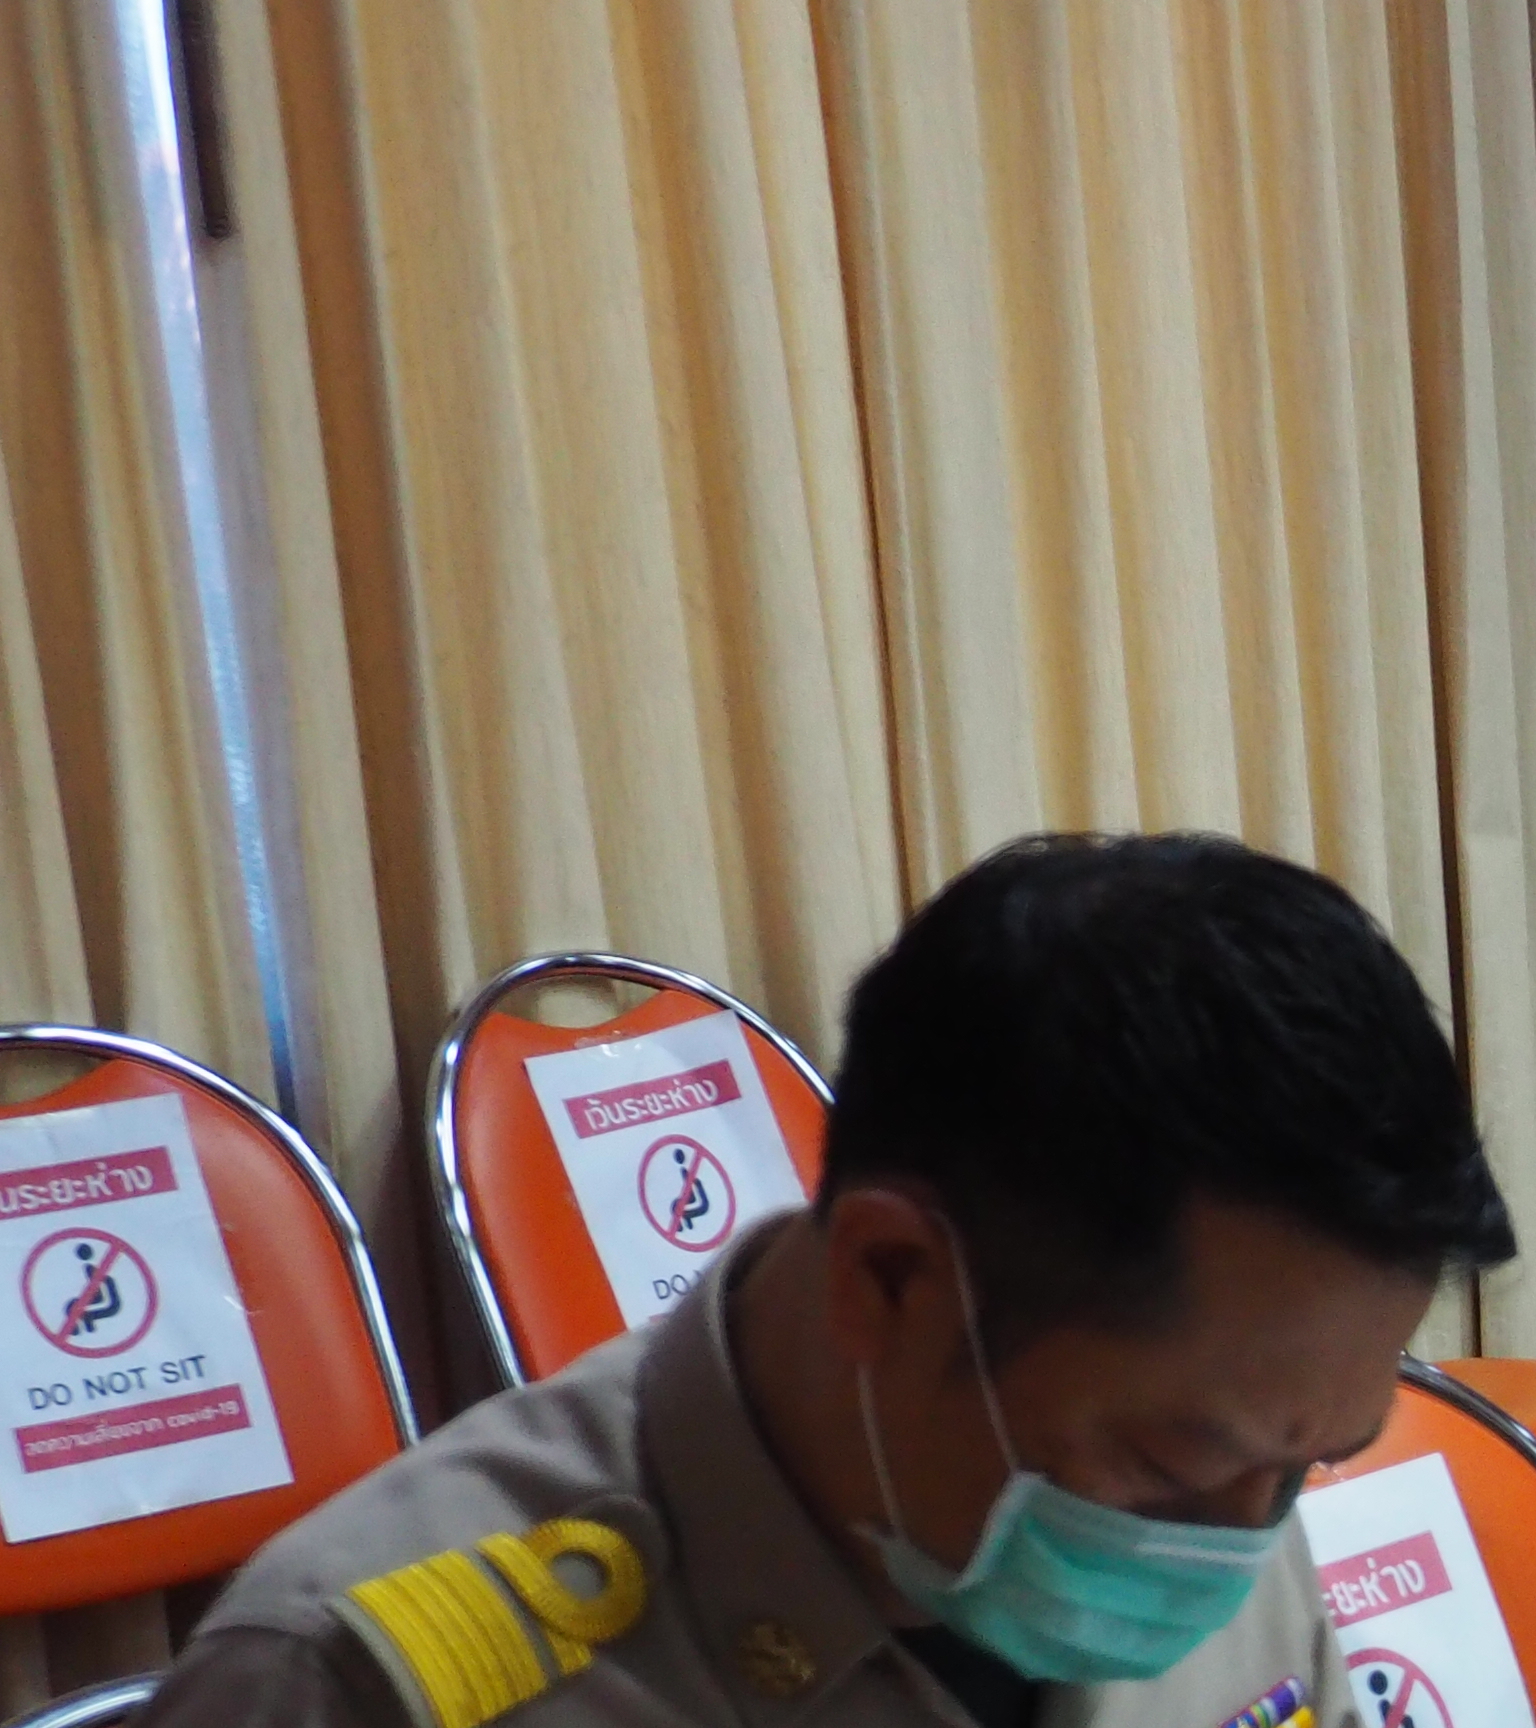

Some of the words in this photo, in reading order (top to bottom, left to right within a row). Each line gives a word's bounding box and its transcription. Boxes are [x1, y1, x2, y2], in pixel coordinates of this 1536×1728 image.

[653, 1274, 689, 1300] DO
[27, 1383, 72, 1410] DO
[83, 1367, 147, 1400] NOT
[160, 1354, 206, 1384] SIT
